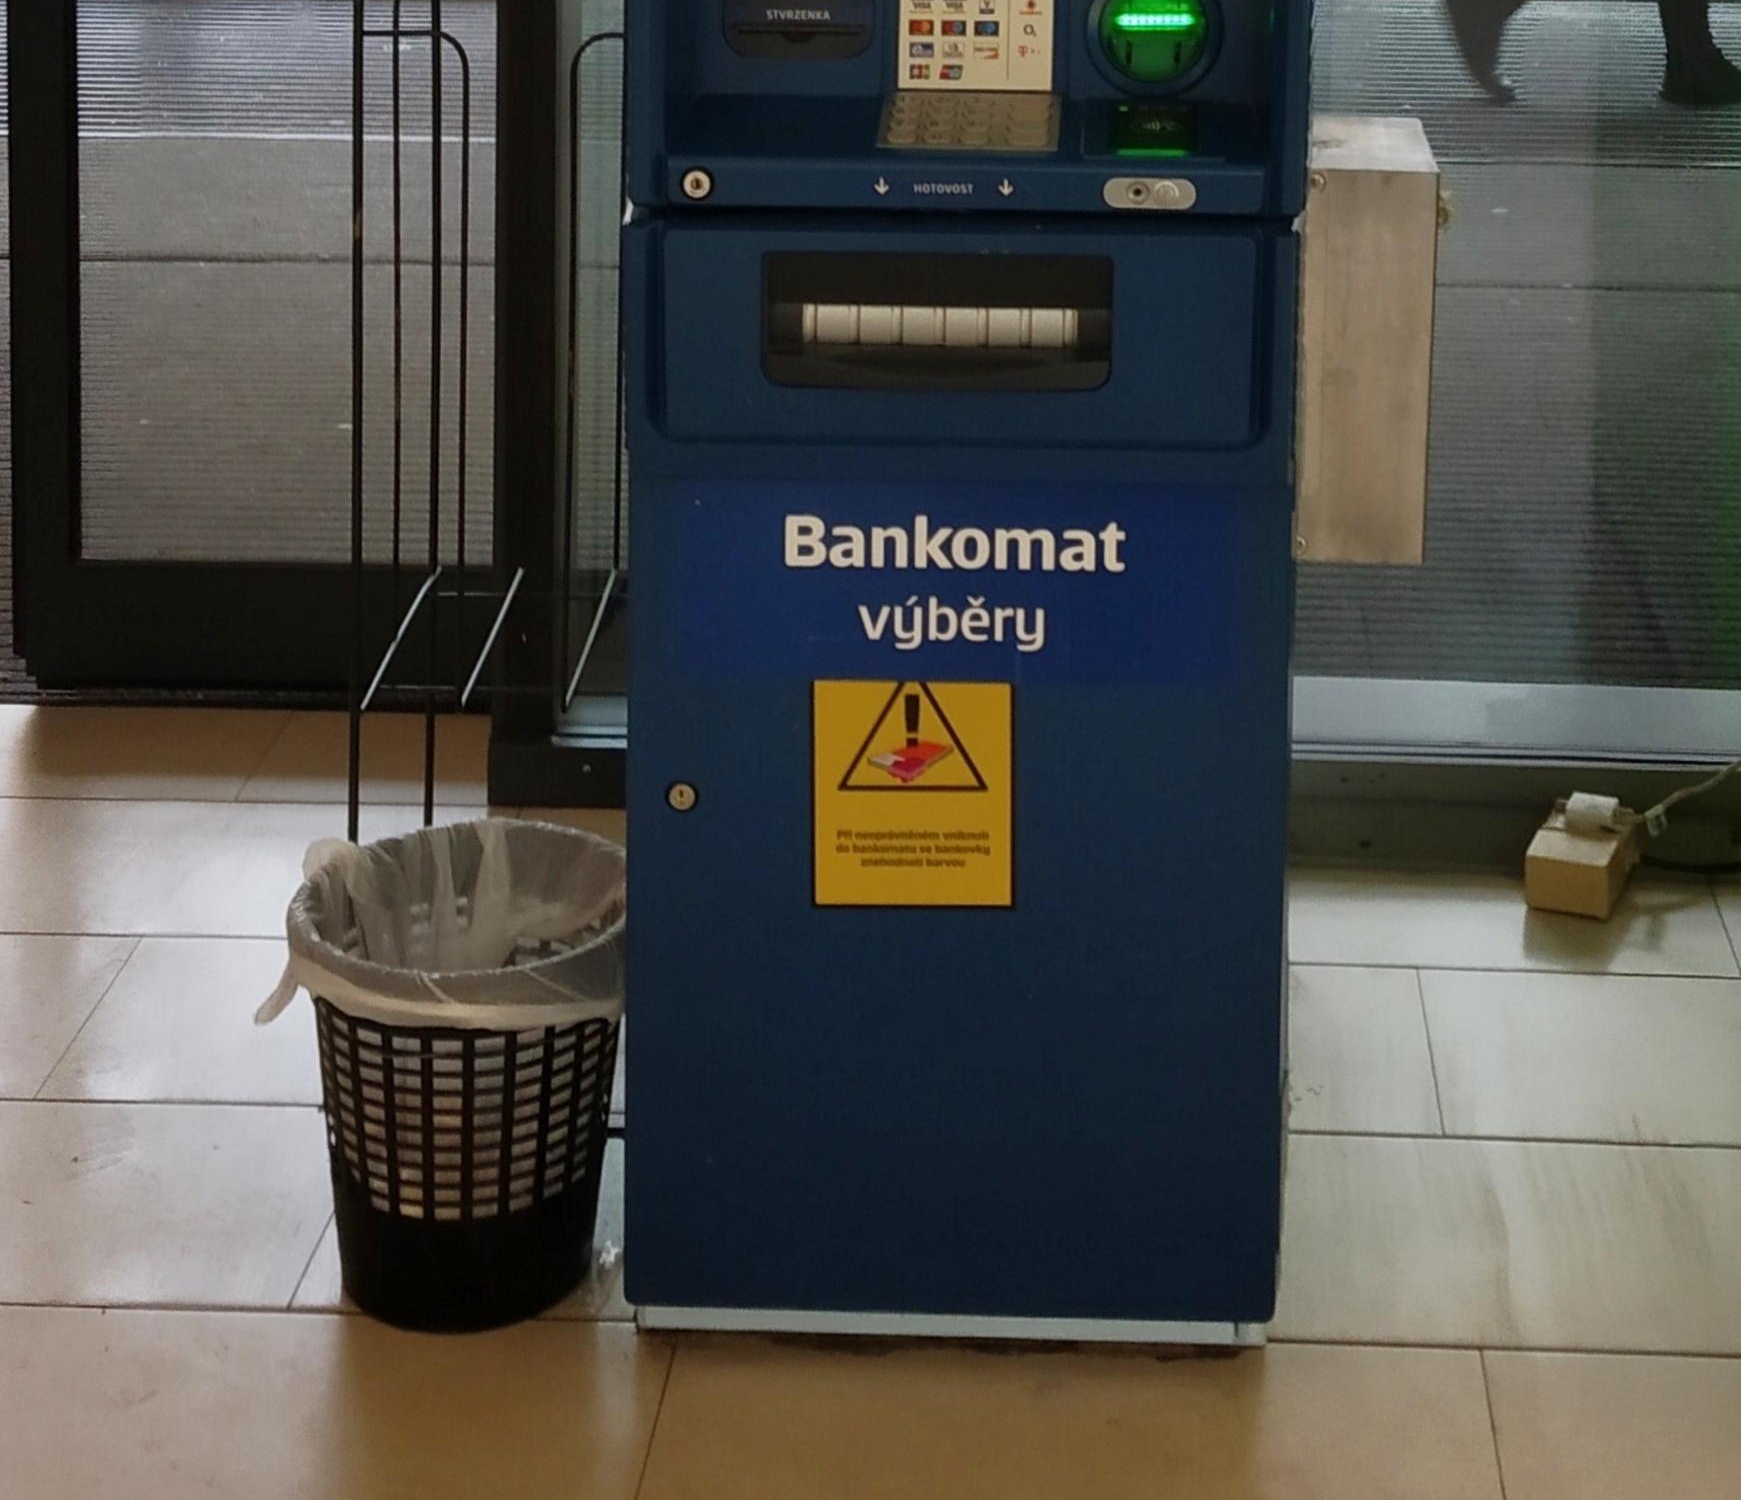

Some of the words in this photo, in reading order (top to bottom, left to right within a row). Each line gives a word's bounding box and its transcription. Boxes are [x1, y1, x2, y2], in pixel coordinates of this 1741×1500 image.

[766, 8, 831, 21] STVRZENKA
[913, 183, 974, 194] HOTOVOST
[783, 513, 1127, 573] Bankomat
[857, 594, 1046, 653] výběry
